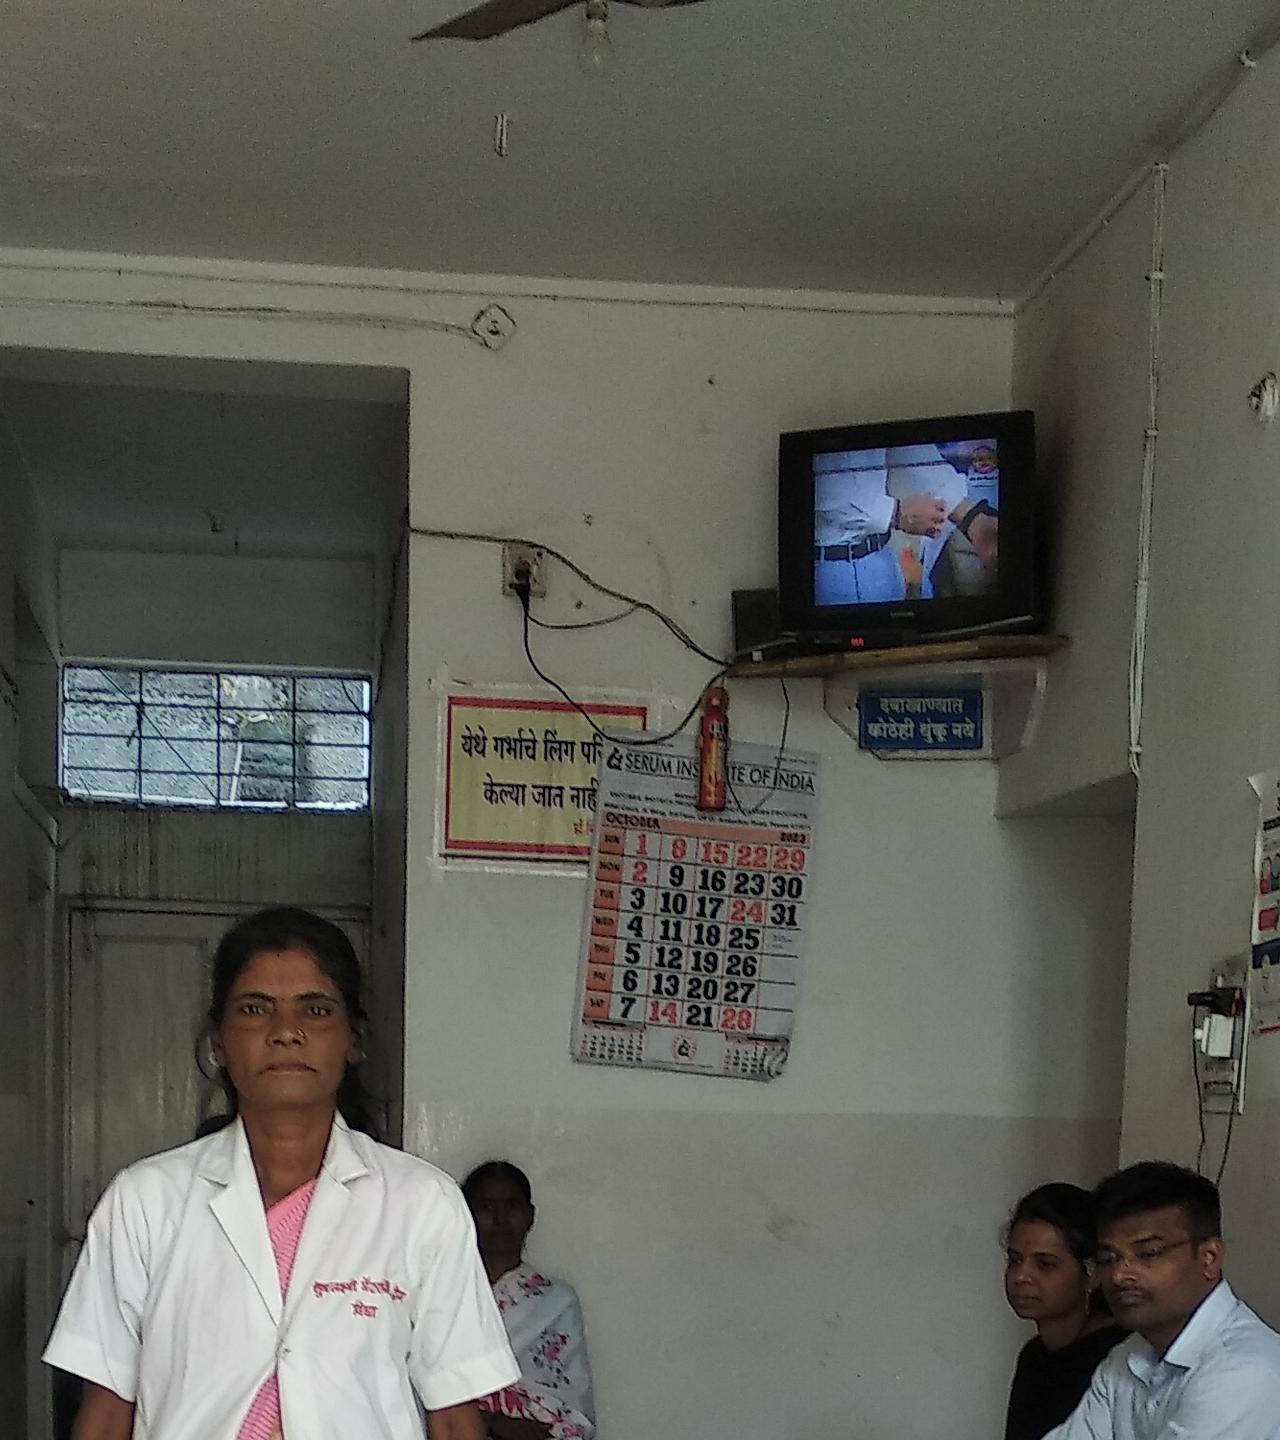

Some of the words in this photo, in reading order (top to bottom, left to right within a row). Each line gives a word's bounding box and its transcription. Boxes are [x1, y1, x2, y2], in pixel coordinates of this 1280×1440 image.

[461, 725, 487, 758] येथे
[493, 727, 537, 761] गर्भाचे
[544, 729, 576, 763] लिंग
[867, 717, 915, 740] कोठेही
[919, 718, 950, 744] थुंकू
[951, 717, 976, 738] नये
[483, 772, 526, 806] केल्या
[531, 784, 565, 808] जात
[624, 754, 672, 775] SERUM
[749, 768, 771, 785] OF
[774, 768, 815, 792] INDIA
[606, 811, 661, 829] OCTOBER
[780, 832, 806, 845] 2023
[637, 833, 648, 855] 1
[671, 838, 688, 861] 8
[701, 841, 729, 865] 15
[735, 845, 768, 868] 22
[772, 849, 806, 872] 29
[599, 862, 620, 871] MON
[632, 861, 648, 883] 2
[669, 865, 684, 887] 9
[698, 868, 726, 892] 16
[734, 872, 765, 895] 23
[771, 875, 803, 899] 30
[630, 887, 646, 910] 3
[660, 891, 688, 915] 10
[696, 895, 724, 919] 17
[730, 899, 764, 923] 24
[770, 903, 797, 927] 31
[627, 916, 643, 938] 4
[659, 919, 683, 942] 11
[694, 923, 721, 947] 18
[728, 927, 761, 950] 25
[624, 942, 642, 964] 5
[654, 946, 682, 970] 12
[690, 950, 719, 974] 19
[725, 954, 758, 977] 26
[623, 969, 638, 991] 6
[652, 973, 679, 997] 13
[686, 977, 718, 1000] 20
[723, 981, 756, 1004] 27
[620, 997, 637, 1019] 7
[648, 1001, 677, 1025] 14
[686, 1004, 714, 1028] 21
[721, 1008, 753, 1031] 28
